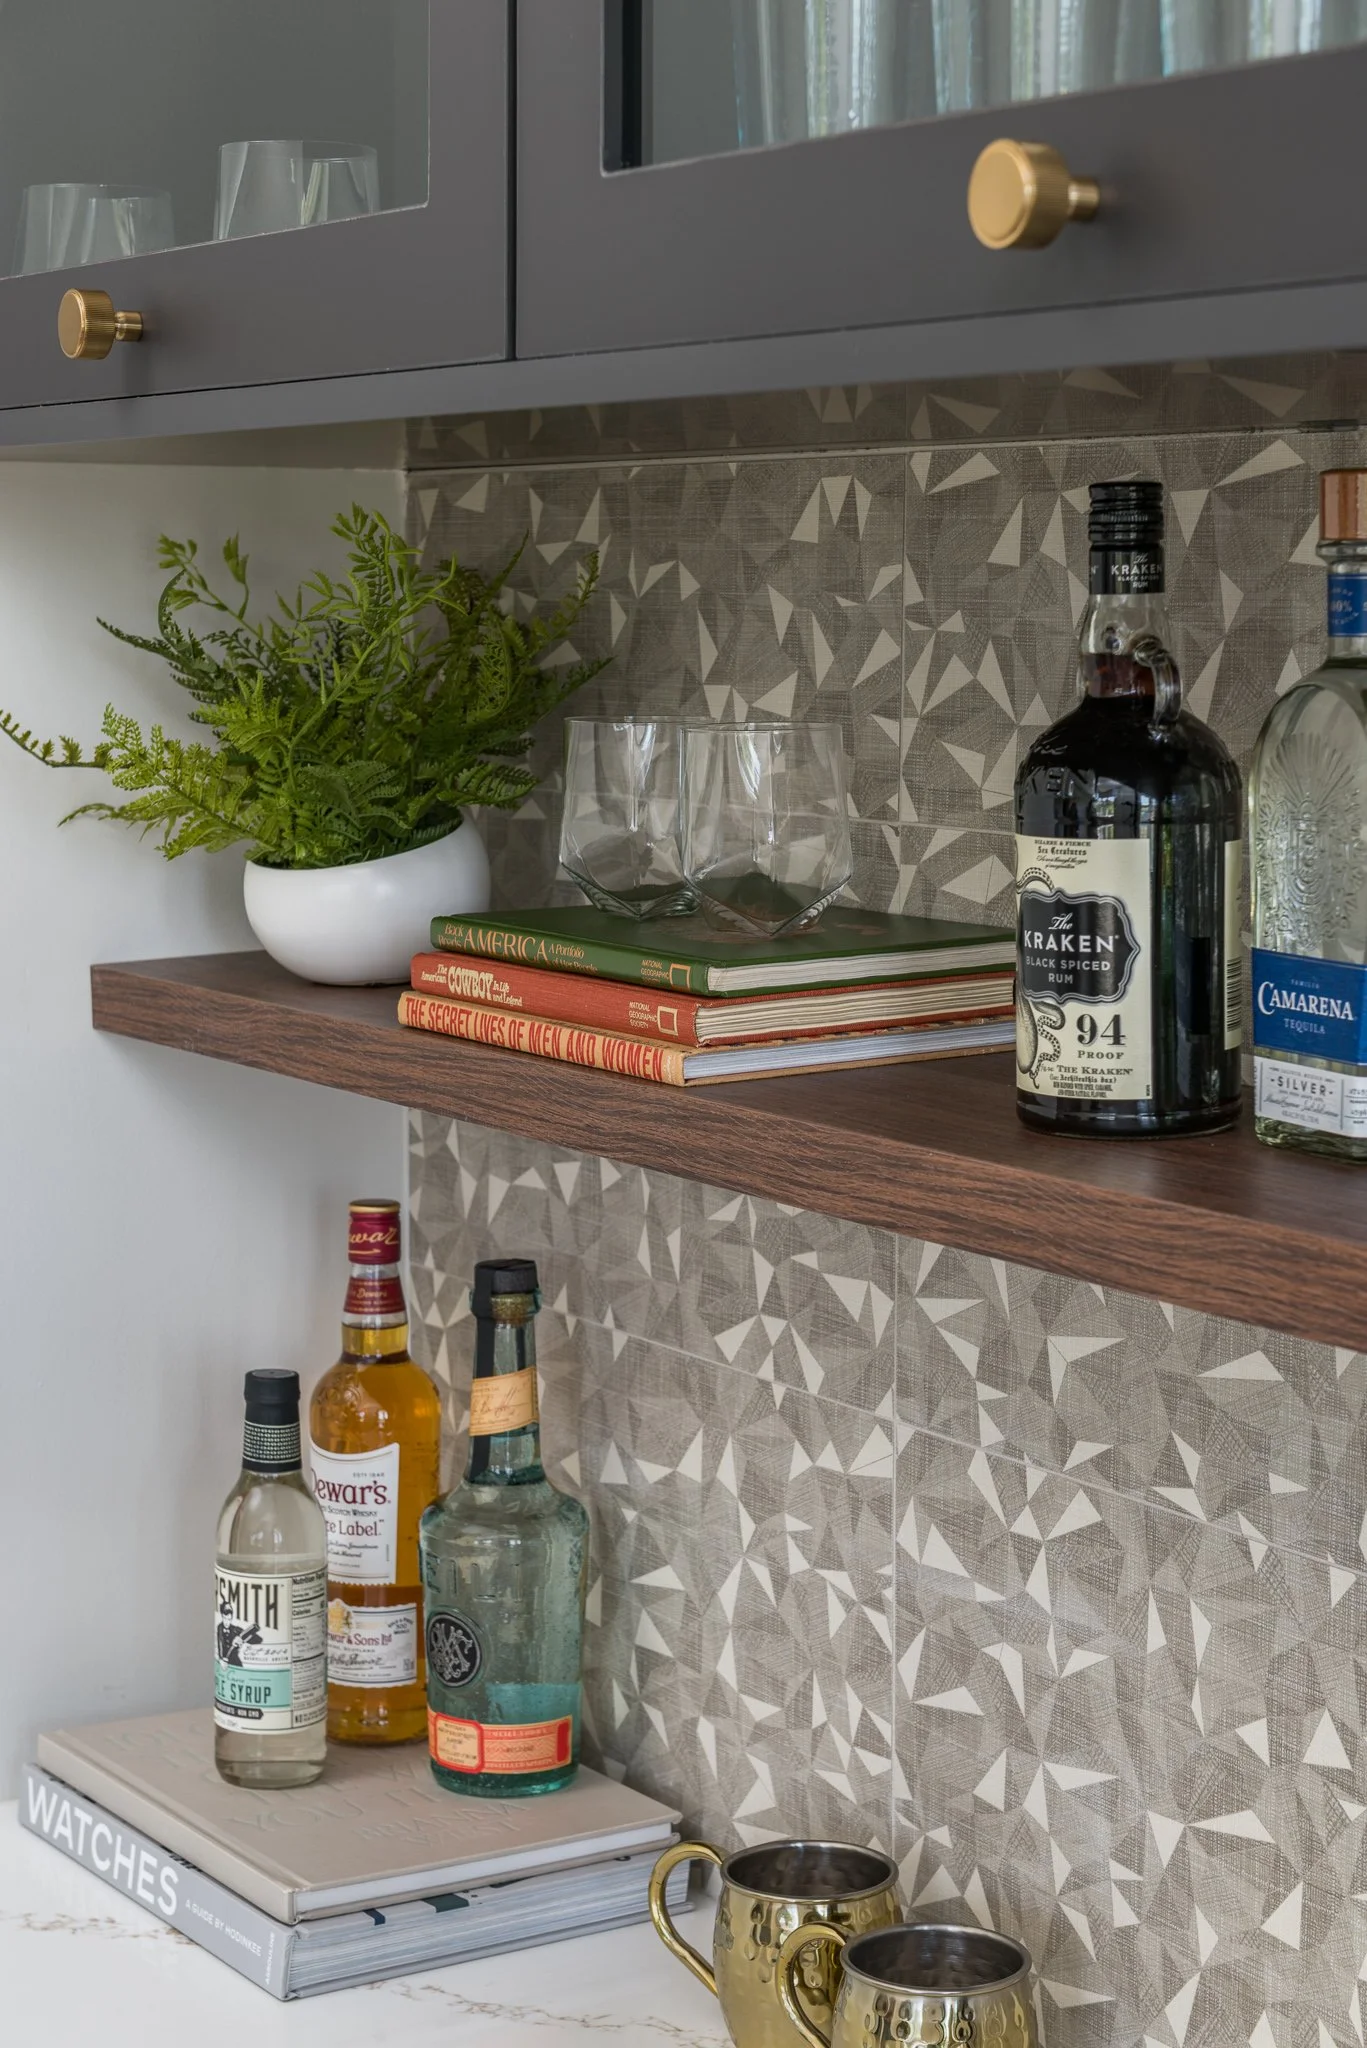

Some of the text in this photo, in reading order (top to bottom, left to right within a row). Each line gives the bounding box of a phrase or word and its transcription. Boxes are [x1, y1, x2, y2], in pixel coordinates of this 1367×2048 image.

[1111, 564, 1163, 575] KRAKEN
[1132, 581, 1149, 589] RUM
[1048, 912, 1074, 930] The
[444, 923, 464, 938] Back
[463, 927, 550, 966] AMERICA
[555, 943, 586, 959] Portfolio
[1024, 930, 1115, 953] KRAKEN
[641, 958, 663, 970] NATIONAL
[1025, 956, 1112, 971] BLACK SPICED
[437, 963, 448, 975] The
[447, 965, 494, 1001] COWBOY
[500, 980, 510, 994] Life
[640, 967, 670, 981] GEOGRAPHIC
[1048, 972, 1074, 985] RUM
[421, 971, 523, 1007] American and Legend
[629, 1001, 650, 1013] NATIONAL
[1258, 981, 1355, 1021] CAMARENA
[628, 1010, 658, 1023] GEOGRAPHIC
[629, 1018, 649, 1029] SOCIETY
[1076, 1013, 1128, 1047] 94
[1283, 1018, 1326, 1034] TEQUILA
[405, 996, 427, 1029] THE
[427, 1001, 473, 1040] SECRET
[473, 1011, 506, 1046] LIVES
[508, 1018, 526, 1050] OF
[528, 1020, 563, 1059] MEN
[566, 1029, 597, 1067] AND
[602, 1037, 665, 1082] WOMEN
[1077, 1050, 1125, 1060] PROOF
[1056, 1064, 1078, 1074] THE
[1081, 1066, 1130, 1076] KRAKEN
[1277, 1075, 1326, 1097] SILVER
[339, 1520, 379, 1536] Label
[354, 1632, 380, 1646] Sons
[230, 1683, 272, 1705] SYRUP
[27, 1775, 180, 1917] WATCHES
[191, 1903, 214, 1926] GUIDE
[214, 1917, 225, 1931] BY
[225, 1925, 263, 1957] HODINKEE
